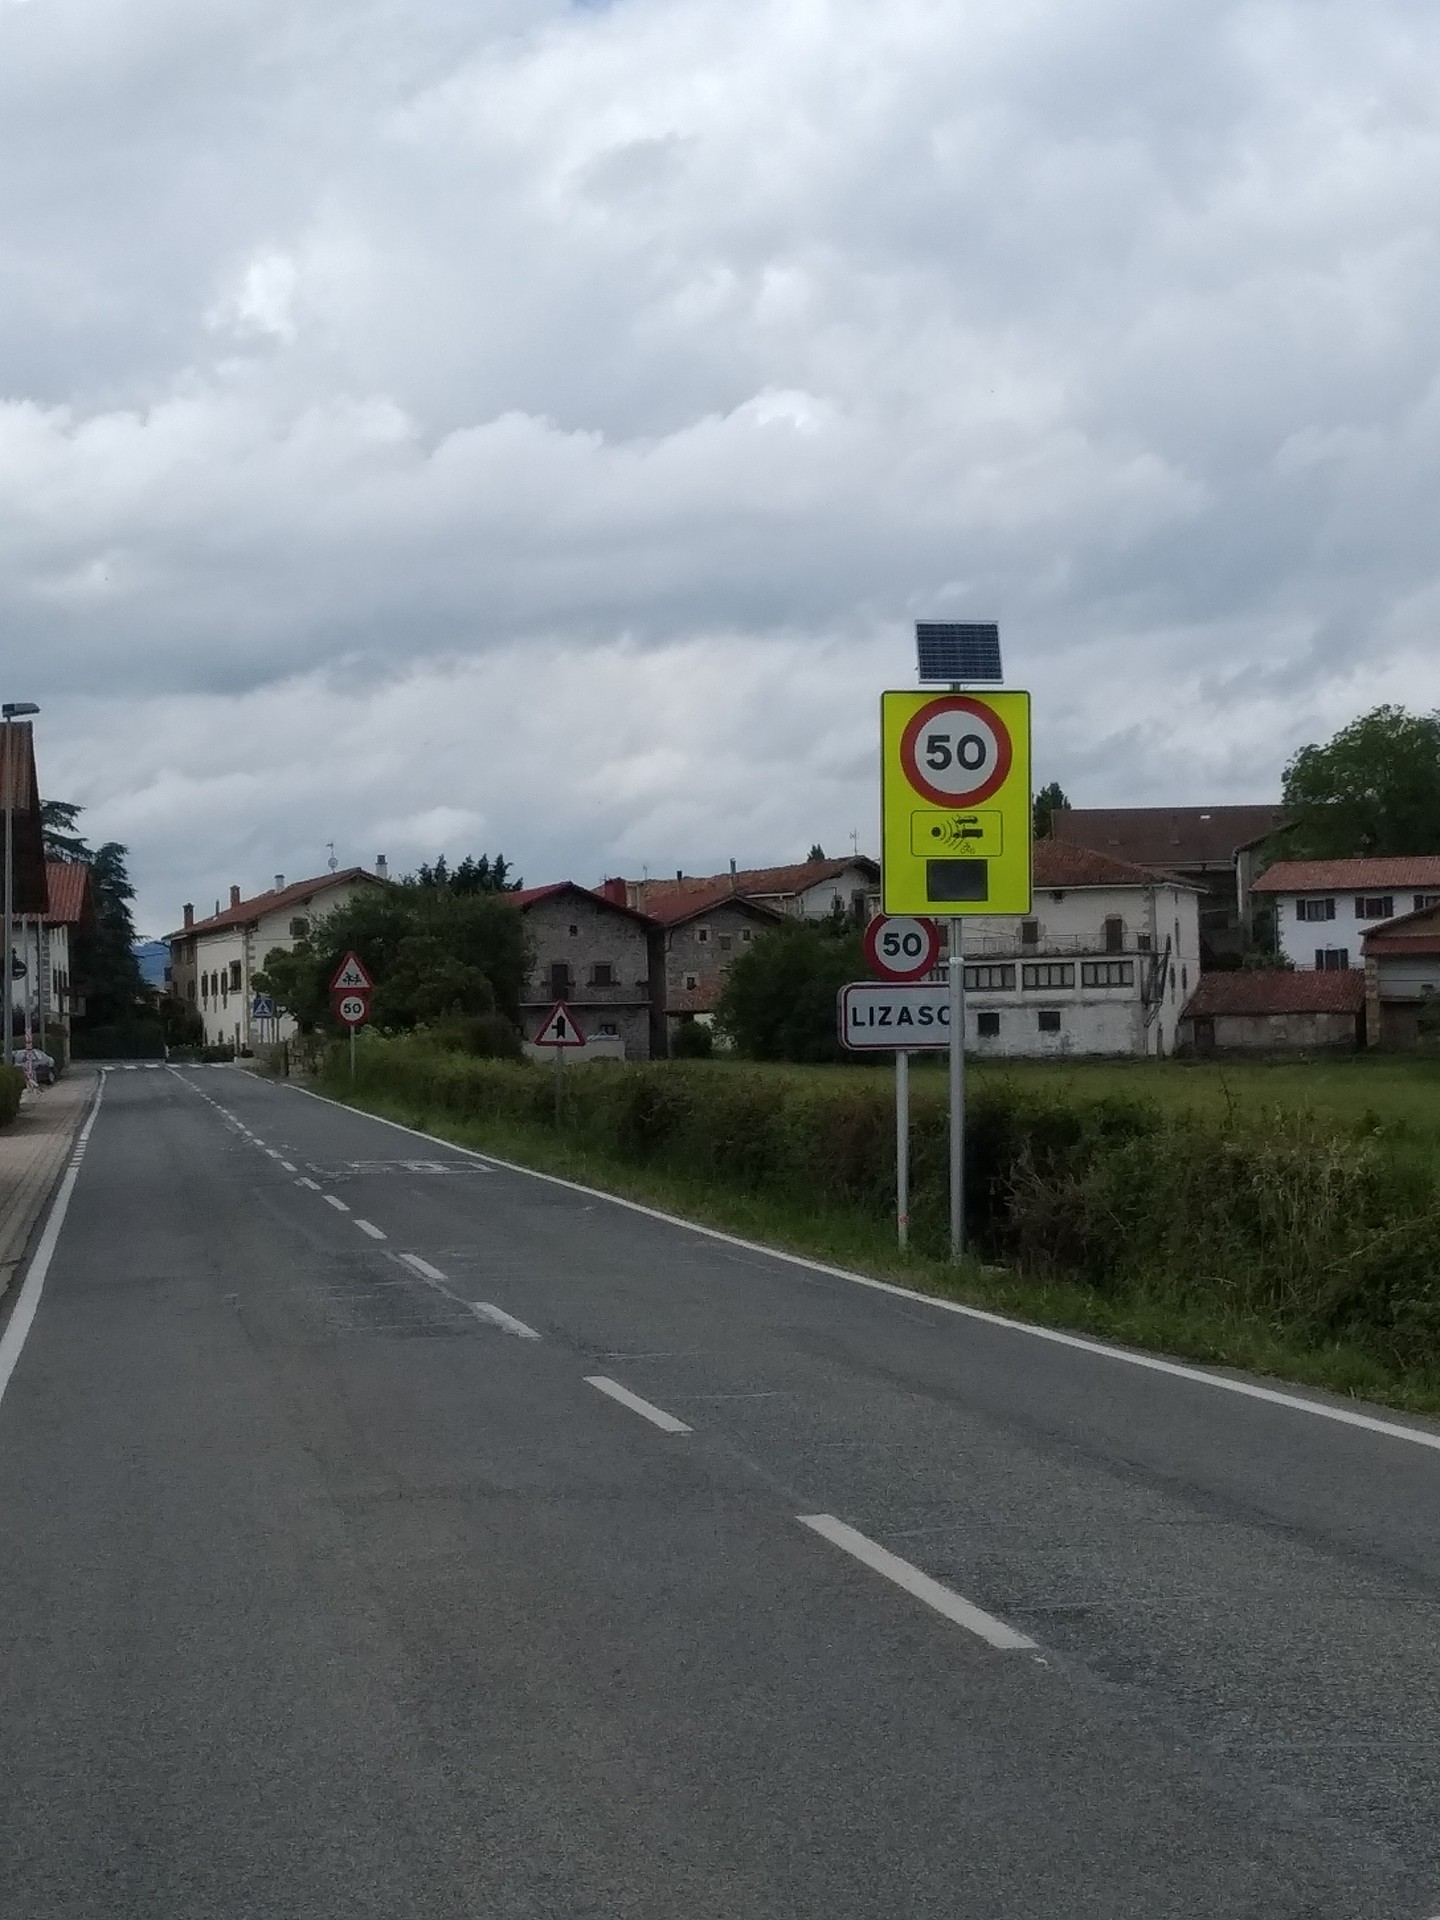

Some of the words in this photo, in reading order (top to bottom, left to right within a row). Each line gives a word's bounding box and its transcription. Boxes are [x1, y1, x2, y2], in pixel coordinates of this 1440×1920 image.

[926, 734, 986, 770] 50
[883, 932, 922, 957] 50
[343, 1003, 362, 1014] 50
